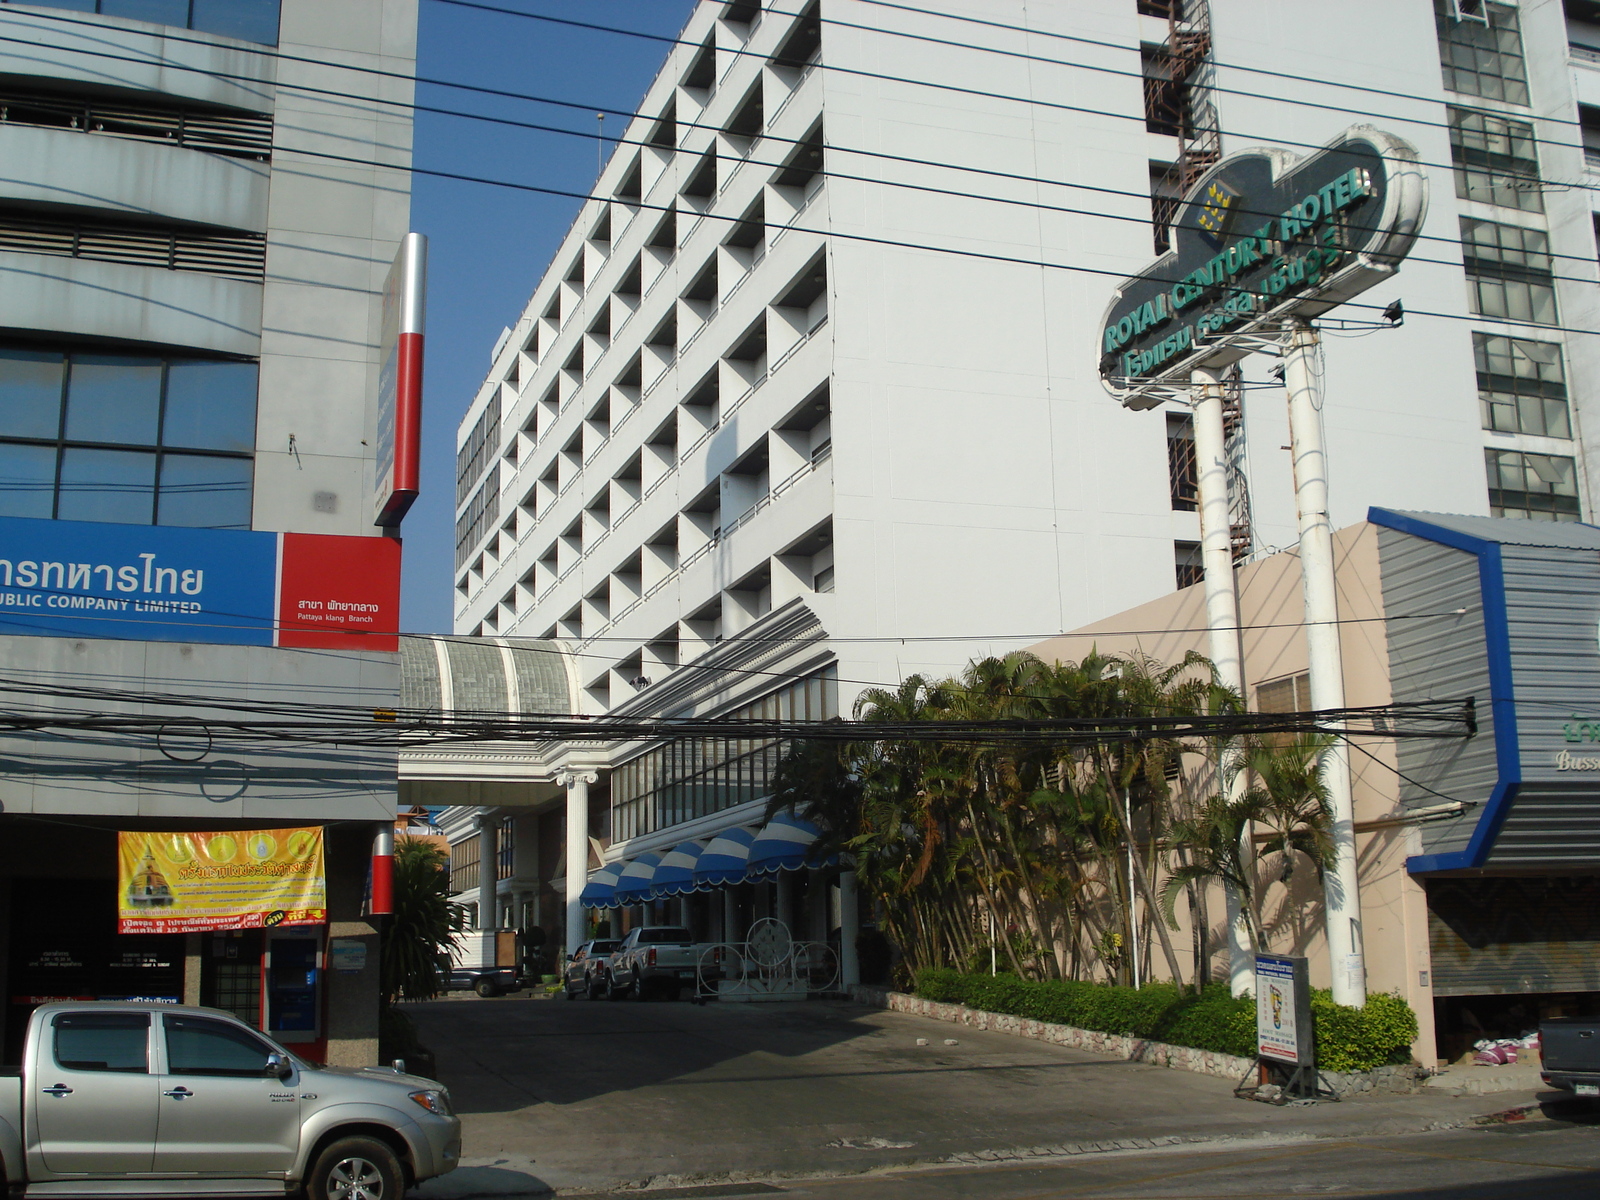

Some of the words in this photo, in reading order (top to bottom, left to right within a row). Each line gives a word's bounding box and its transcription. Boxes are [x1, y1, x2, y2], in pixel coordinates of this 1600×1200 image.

[1105, 293, 1169, 352] ROYAL
[1172, 220, 1273, 309] CENTURY
[1280, 167, 1369, 242] HOTEL
[1124, 326, 1191, 377] โรงแรม
[47, 595, 130, 611] COMPANY
[135, 599, 202, 614] LIMITED
[298, 600, 323, 609] สาขา
[327, 599, 379, 612] พัทยากลาง
[297, 613, 323, 622] Pattaya
[325, 614, 345, 623] klang
[348, 615, 373, 623] Branch
